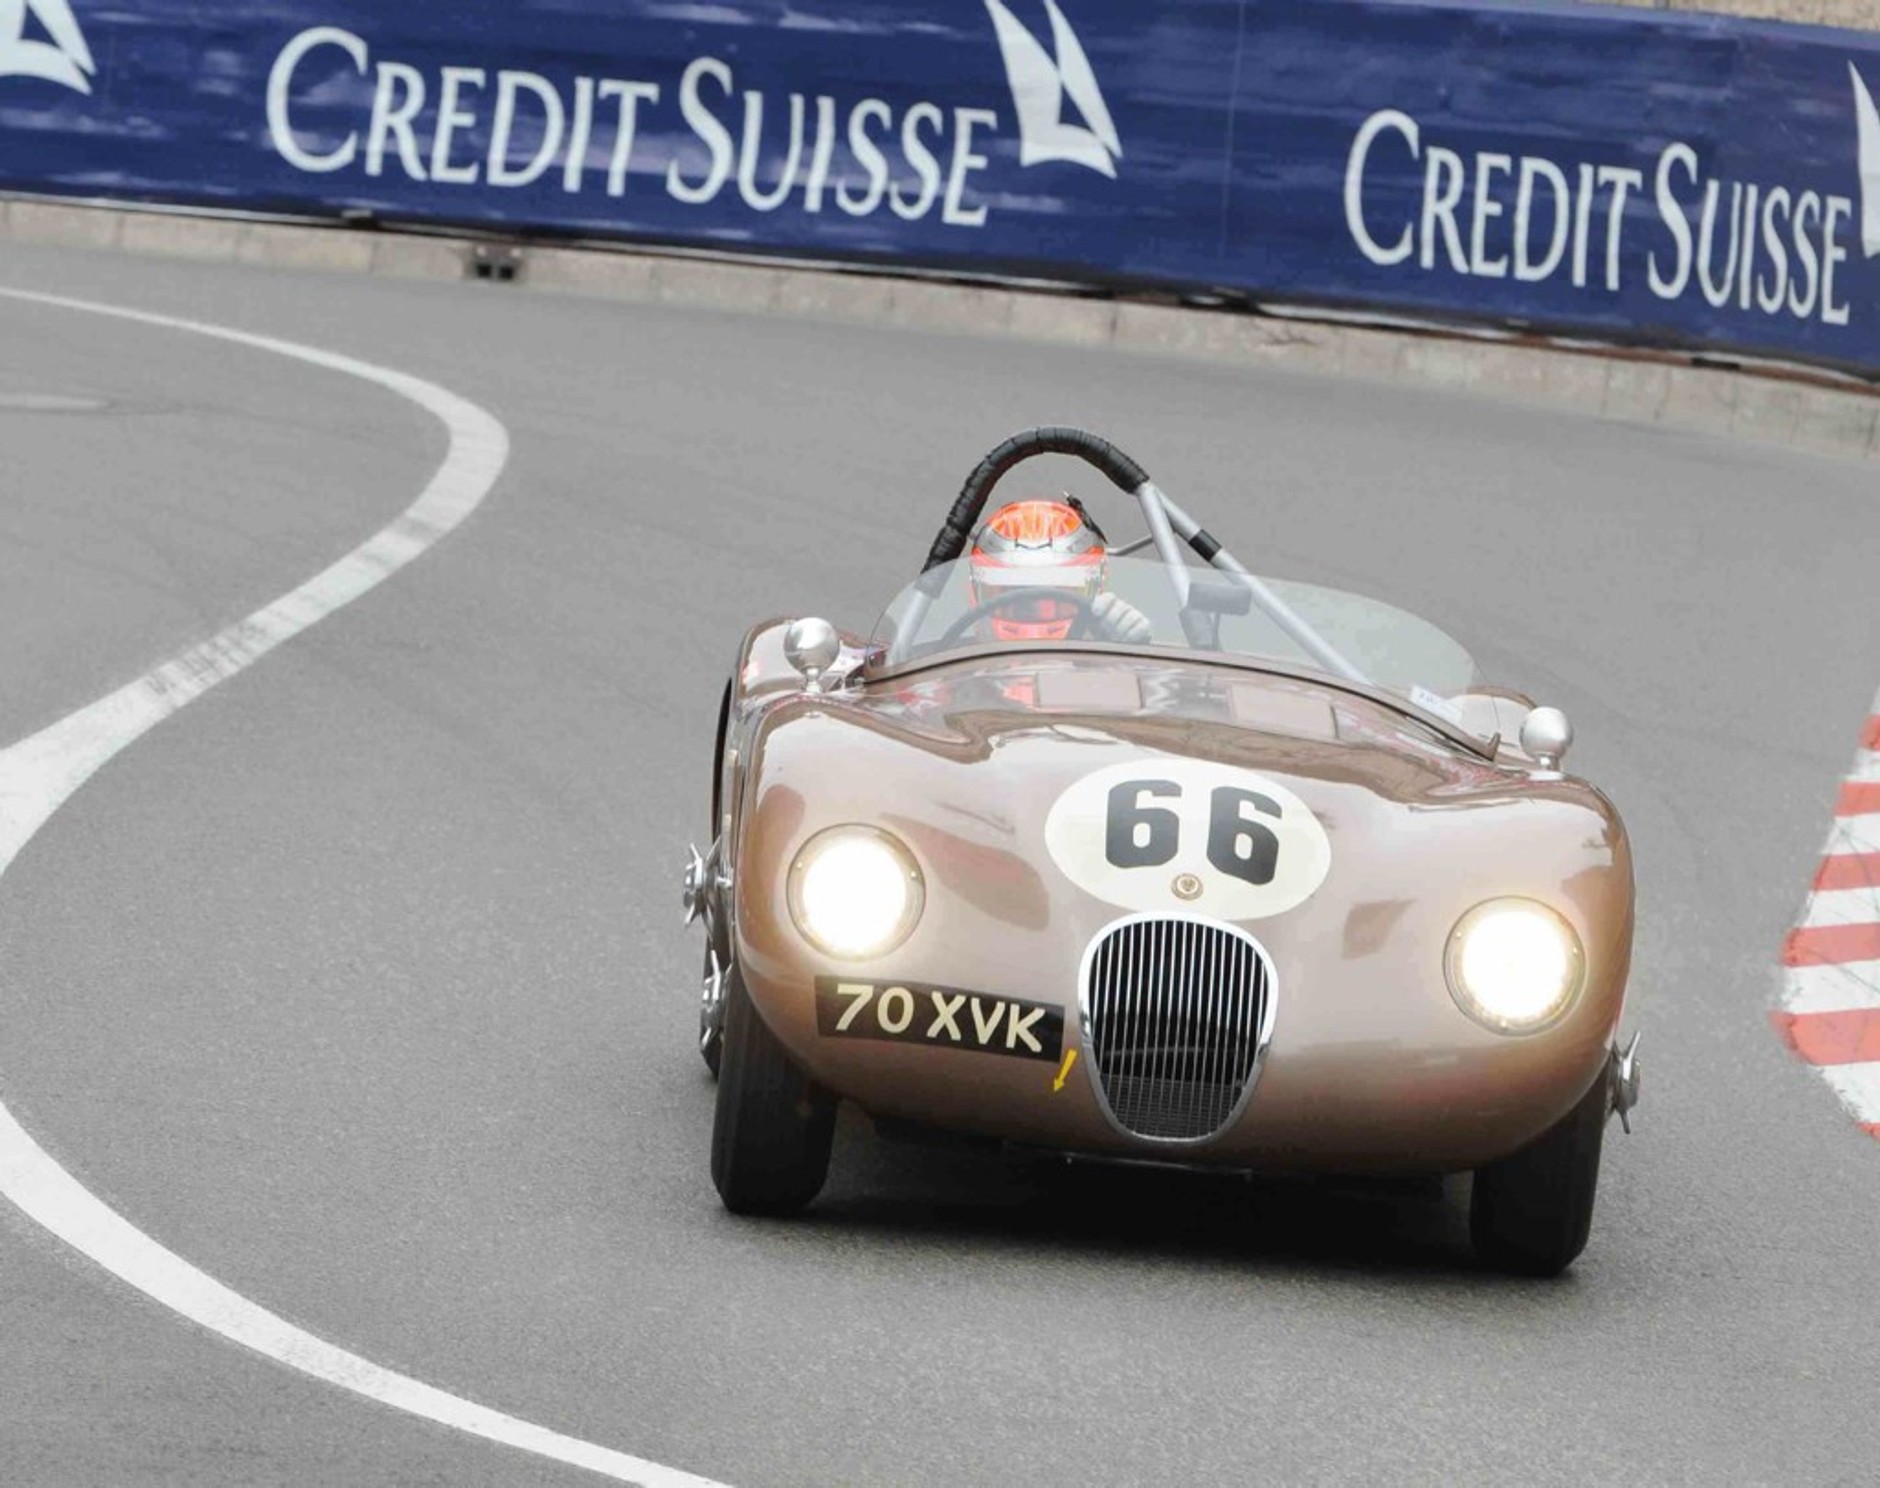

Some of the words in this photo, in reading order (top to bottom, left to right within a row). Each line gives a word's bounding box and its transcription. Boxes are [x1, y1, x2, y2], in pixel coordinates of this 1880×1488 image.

[266, 26, 658, 196] CREDIT
[666, 57, 998, 225] SUISSE
[1344, 109, 1642, 290] CREDIT
[1648, 142, 1851, 325] SUISSE
[1105, 779, 1282, 885] 66
[834, 984, 914, 1034] 70
[926, 990, 1047, 1053] XVK
